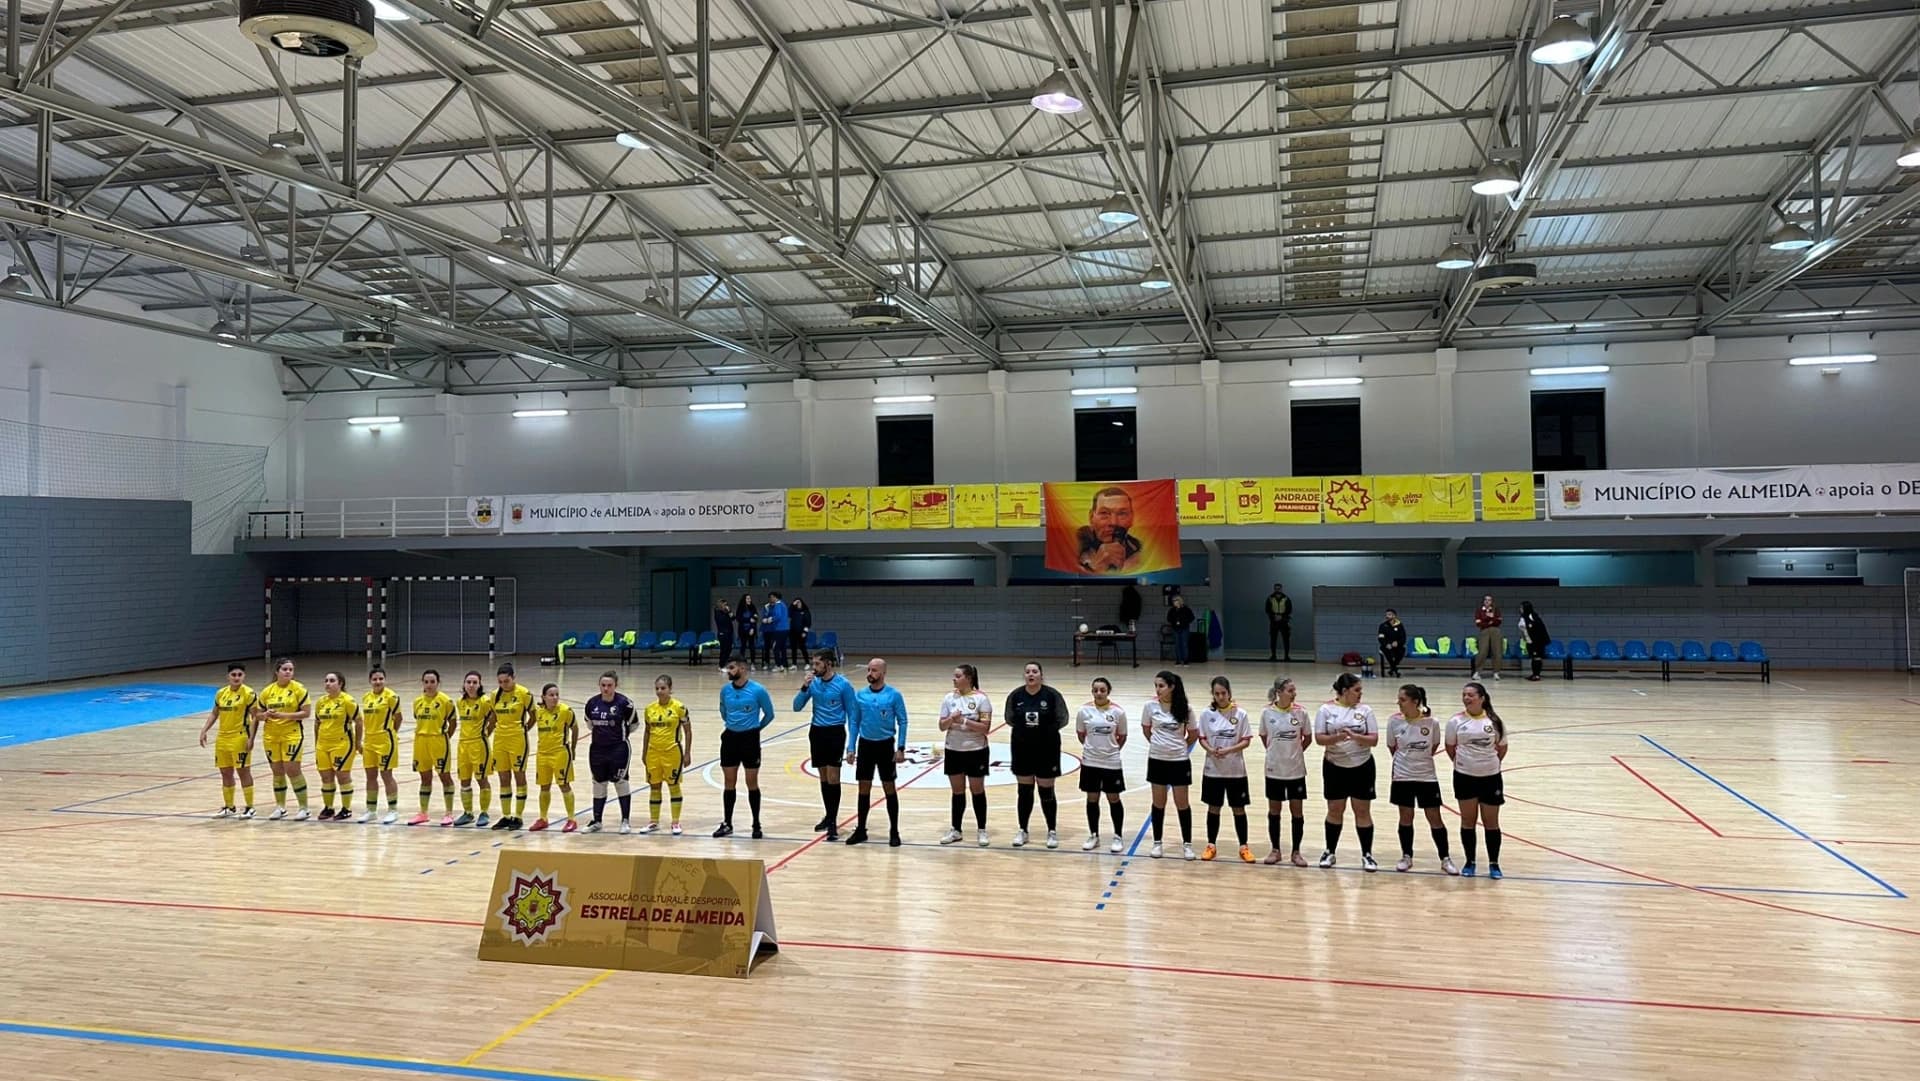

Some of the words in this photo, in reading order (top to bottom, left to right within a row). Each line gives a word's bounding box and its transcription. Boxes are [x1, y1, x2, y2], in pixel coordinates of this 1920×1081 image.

[1274, 493, 1321, 502] ANDRADE
[1594, 482, 1696, 501] MUNICÍPIO
[1702, 485, 1721, 499] de
[1727, 483, 1811, 499] ALMEIDA
[1829, 482, 1874, 499] apoia
[1881, 484, 1892, 496] o
[530, 505, 588, 519] MUNICÍPIO
[590, 508, 602, 517] de
[604, 506, 652, 518] ALMEIDA
[661, 505, 686, 518] apoia
[689, 507, 696, 516] o
[698, 504, 755, 517] DESPORTO
[288, 744, 296, 754] 11
[588, 891, 639, 904] ASSOCIAÇÃO
[640, 894, 682, 905] CULTURAL
[691, 896, 741, 907] DESPORTIVA
[580, 904, 648, 922] ESTRELA
[651, 907, 673, 923] DE
[674, 909, 745, 927] ALMEIDA
